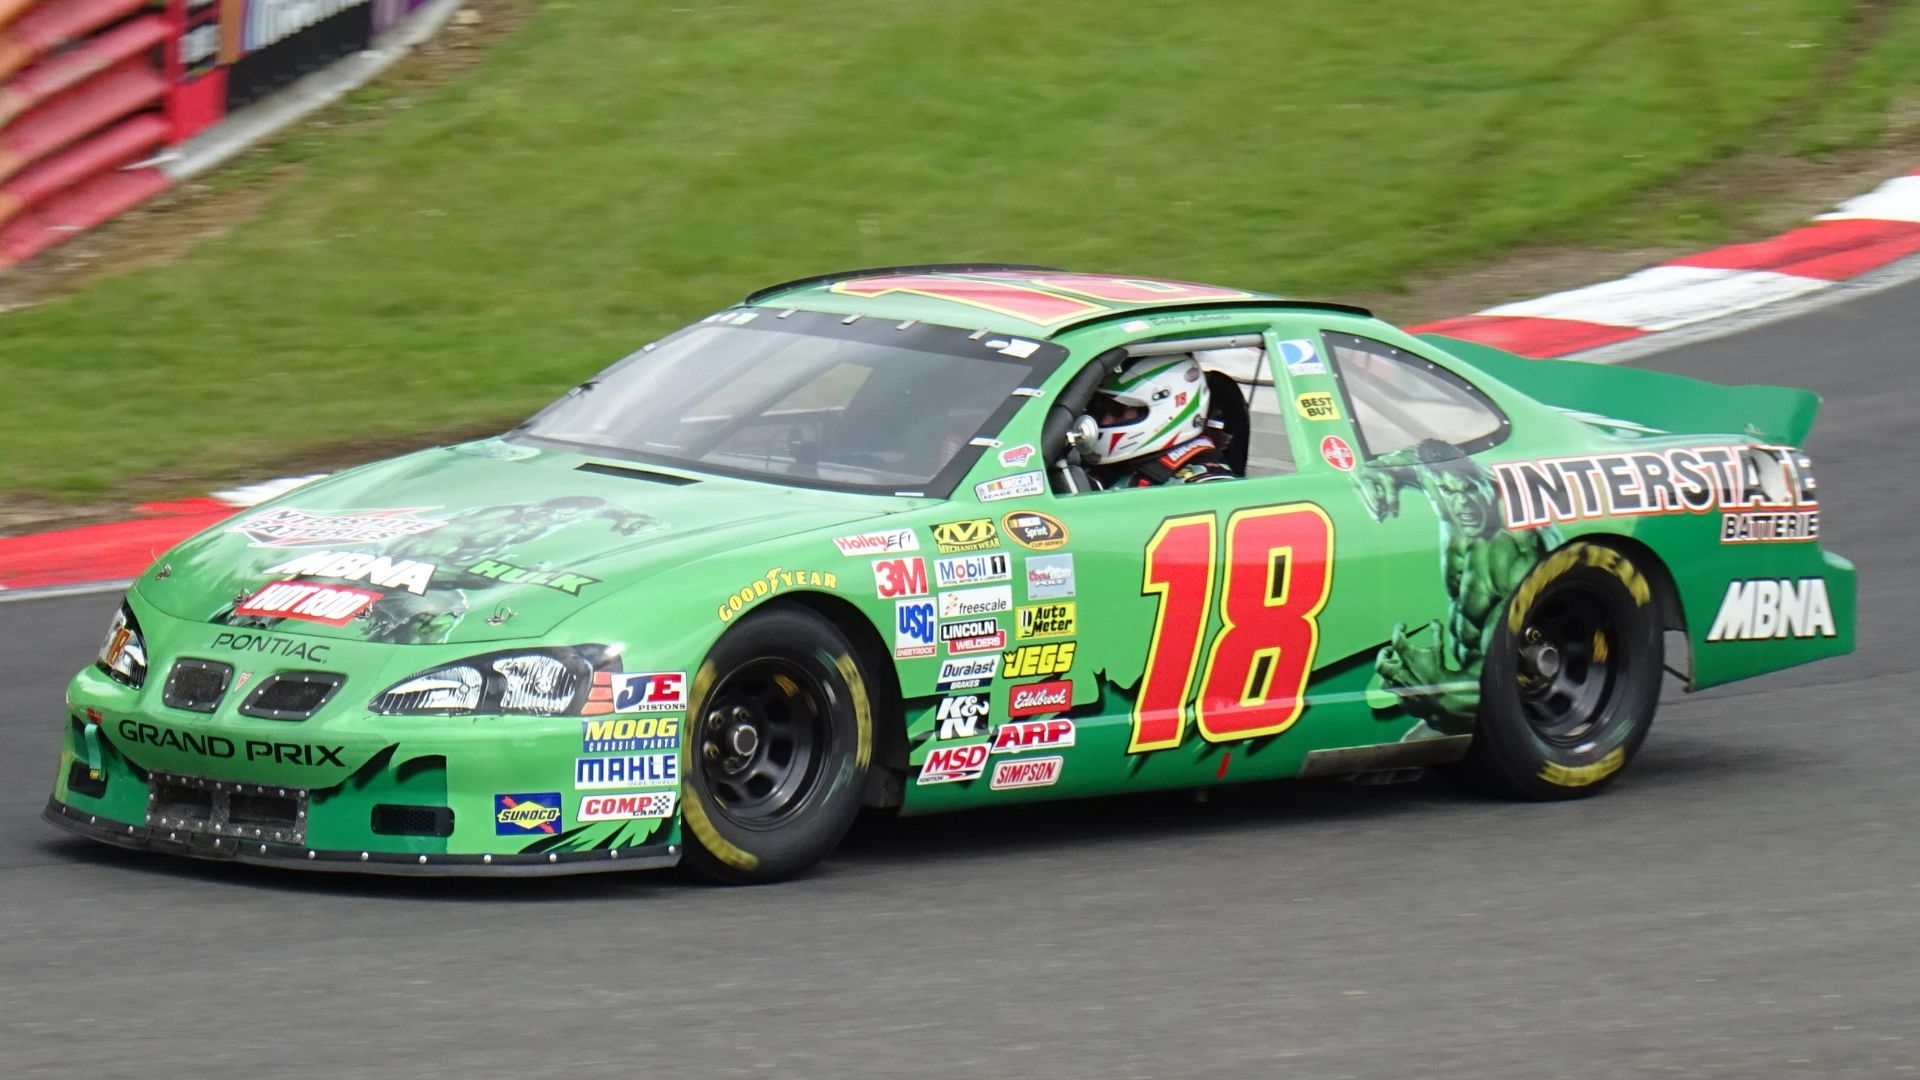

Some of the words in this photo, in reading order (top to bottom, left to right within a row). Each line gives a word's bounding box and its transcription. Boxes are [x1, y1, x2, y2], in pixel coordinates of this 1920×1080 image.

[1301, 396, 1332, 407] BEST
[1307, 406, 1334, 417] BUY
[837, 534, 888, 552] Holley
[886, 531, 912, 549] EFI
[1024, 526, 1049, 540] Sprint
[938, 543, 978, 554] MECHANIX
[977, 538, 1000, 549] WEAR
[262, 550, 437, 596] MBNA
[876, 557, 929, 597] 3M
[939, 557, 987, 580] Mobil
[990, 555, 1006, 575] 1
[466, 560, 600, 596] HULK
[242, 584, 320, 612] HOT
[292, 588, 371, 620] ROD
[718, 567, 838, 622] GOODYEAR
[959, 598, 1007, 615] freescale
[1035, 606, 1066, 620] Auto
[1707, 577, 1836, 641] MBNA
[899, 602, 934, 644] USG
[942, 621, 996, 639] LINCOLN
[1033, 619, 1073, 633] Meter
[1126, 500, 1335, 755] 18
[211, 632, 331, 663] PONTIAC
[896, 647, 934, 656] SHEETROCK
[955, 636, 1000, 650] WELDERS
[943, 659, 995, 678] Duralast
[1003, 641, 1077, 679] JEGS
[616, 673, 682, 710] JE
[951, 679, 980, 689] BRAKES
[638, 703, 687, 711] PISTONS
[1014, 690, 1067, 709] Edelbrock
[584, 717, 679, 742] MOOG
[995, 720, 1073, 749] ARP
[118, 719, 235, 758] GRAND
[245, 740, 347, 768] PRIX
[589, 740, 636, 752] CHASSIS
[643, 738, 675, 749] PARTS
[576, 755, 677, 782] MAHLE
[925, 746, 987, 773] MSD
[919, 776, 945, 784] IGNITION
[997, 762, 1056, 784] SIMPSON
[501, 808, 558, 822] SUNOCO
[585, 797, 653, 816] COMP
[633, 808, 665, 817] CAMS
